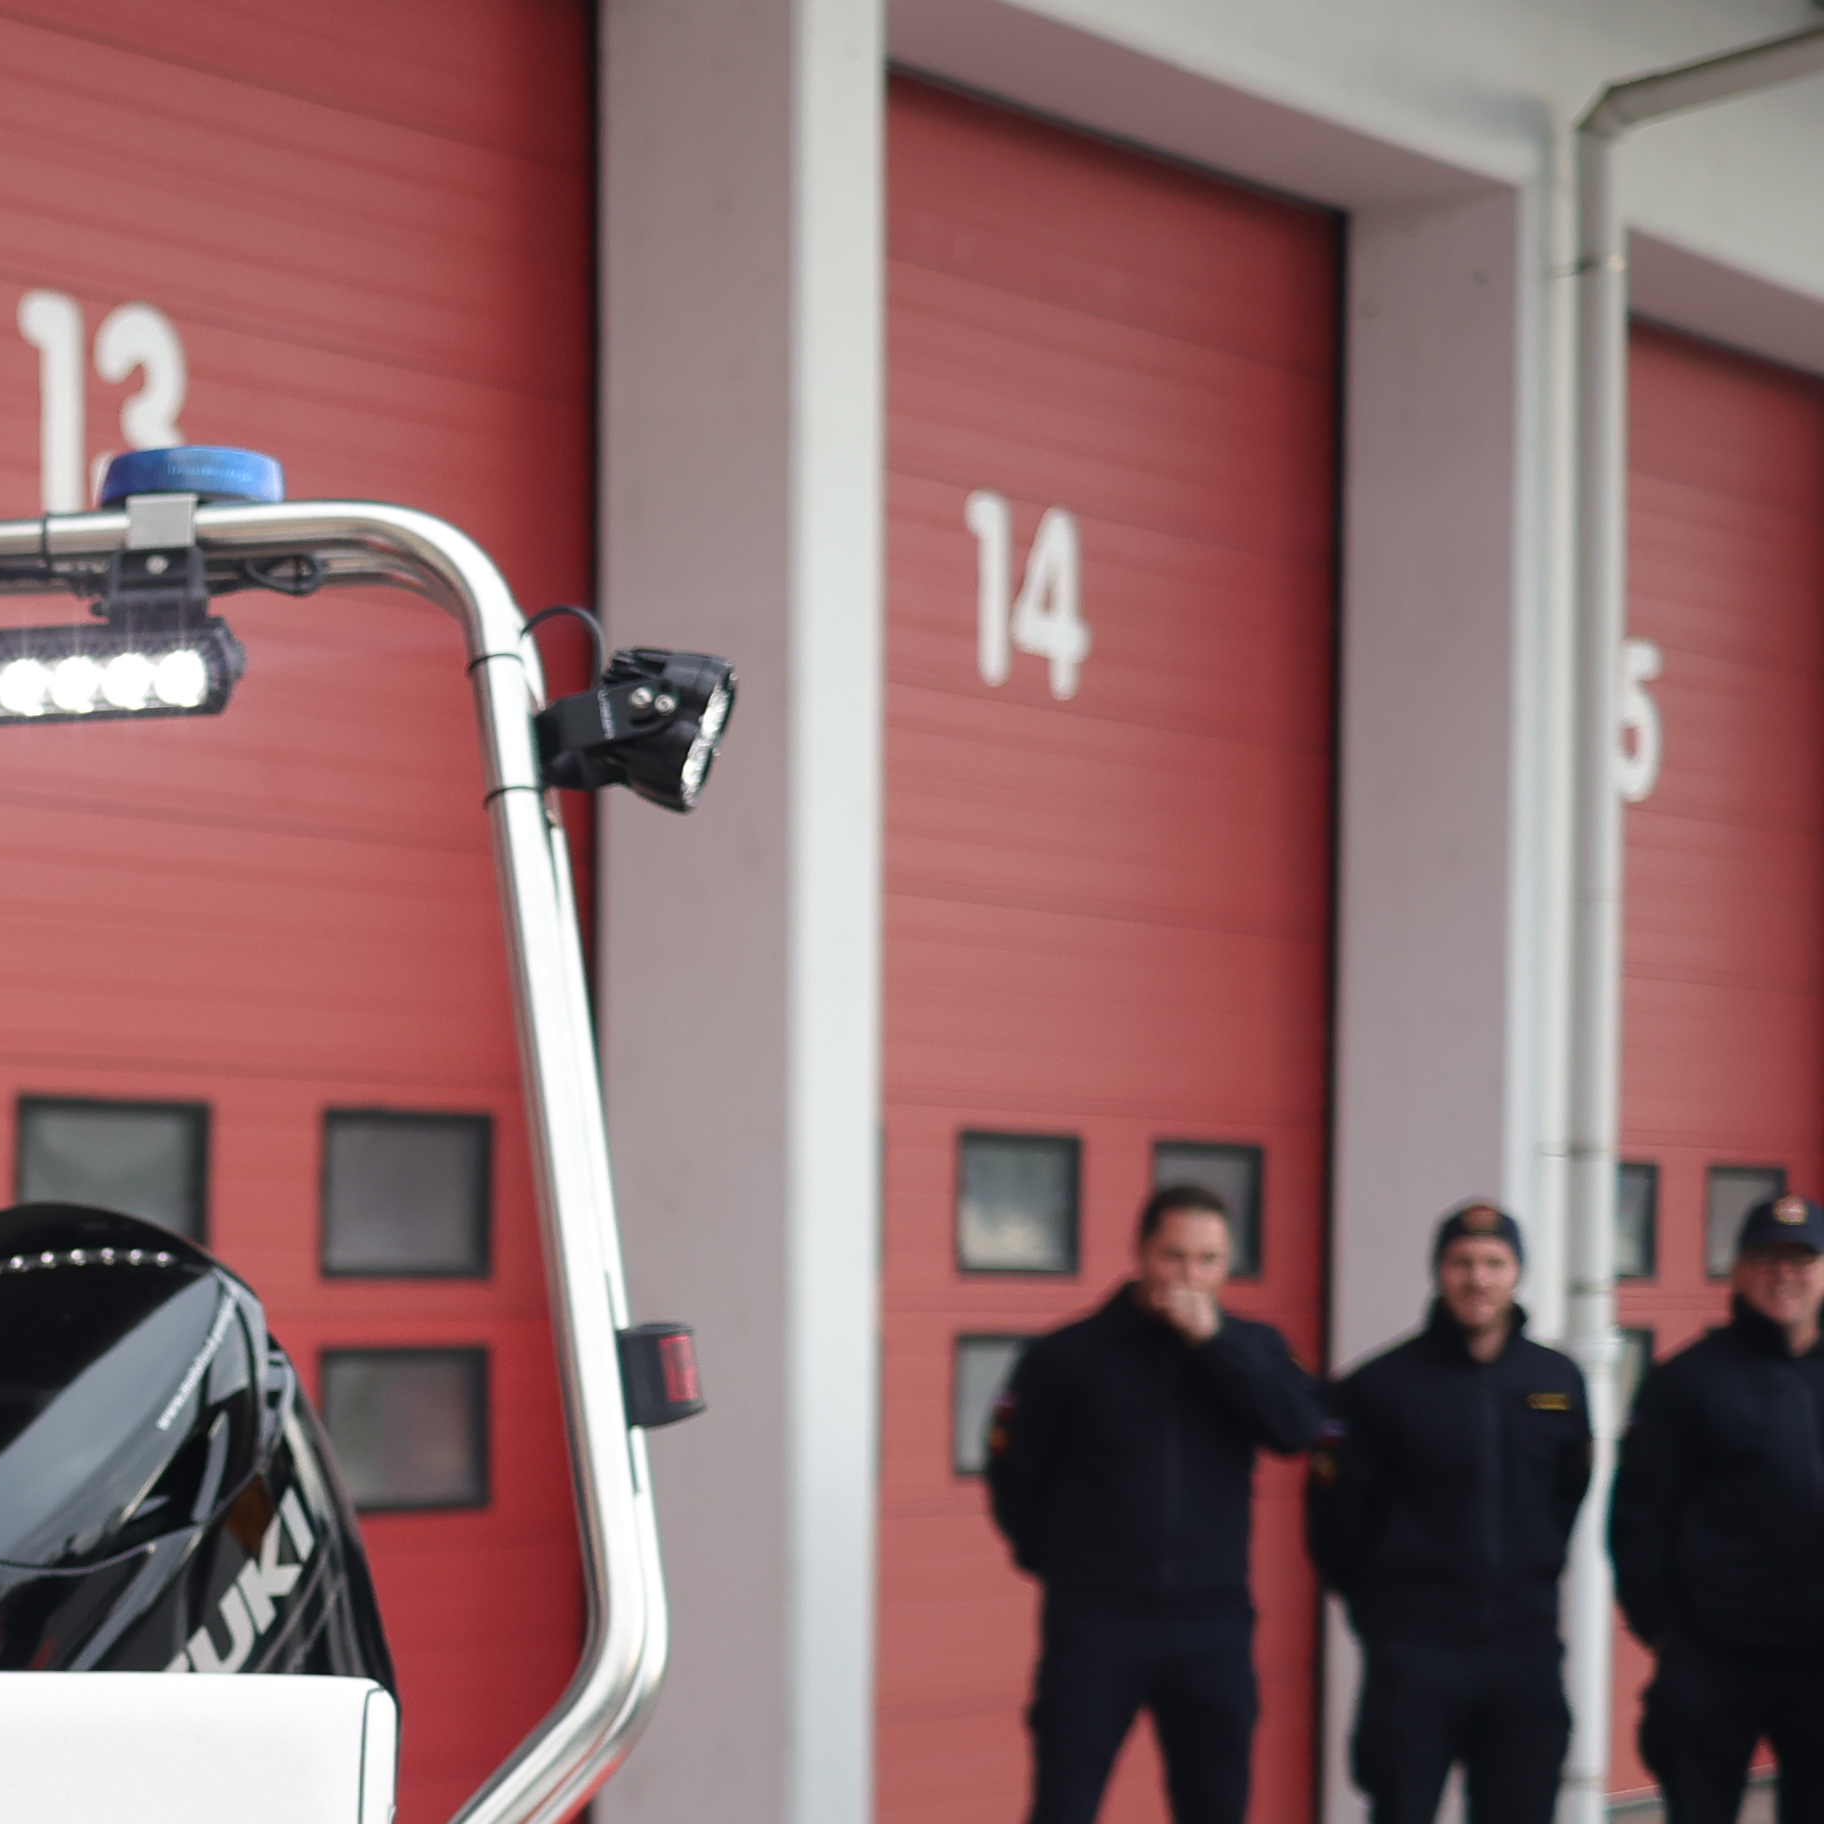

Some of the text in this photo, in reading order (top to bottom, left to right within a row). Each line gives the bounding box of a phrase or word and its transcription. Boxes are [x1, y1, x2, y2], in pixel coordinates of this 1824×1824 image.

[16, 287, 189, 514] 13
[963, 487, 1094, 702] 14
[1623, 636, 1664, 803] 5
[164, 1486, 316, 1674] UKI
